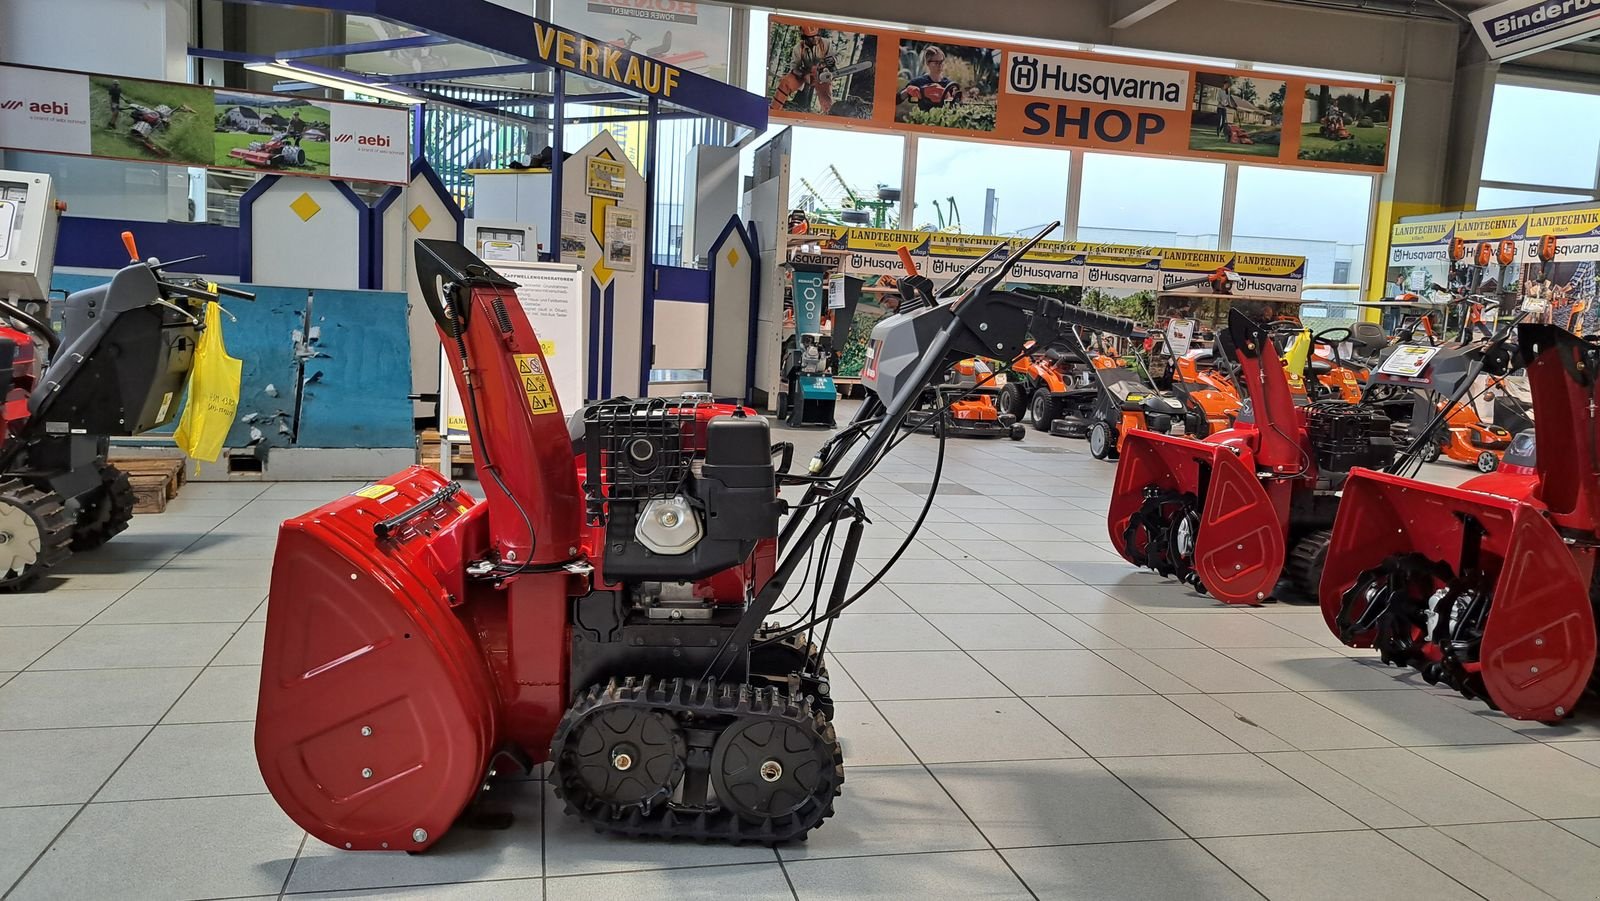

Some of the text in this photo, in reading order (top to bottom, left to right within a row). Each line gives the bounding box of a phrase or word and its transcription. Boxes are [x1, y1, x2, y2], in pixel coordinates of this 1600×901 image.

[533, 22, 681, 97] VERKAUF
[1041, 64, 1181, 103] Husqvarna
[29, 101, 69, 115] aebi
[1022, 102, 1166, 145] SHOP
[358, 134, 390, 147] aebi
[1457, 219, 1518, 231] LANDTECHNIK
[1530, 213, 1599, 227] LANDTECHNIK
[851, 230, 920, 244] LANDTECHNIK
[1395, 224, 1447, 236] LANDTECHNIK
[1164, 251, 1226, 263] LANDTECHNIK
[1237, 255, 1296, 268] LANDTECHNIK
[1402, 249, 1447, 261] Husqvarna
[1023, 266, 1079, 280] Husqvarna
[1100, 270, 1154, 284] Husqvarna
[1247, 279, 1298, 293] Husqvarna
